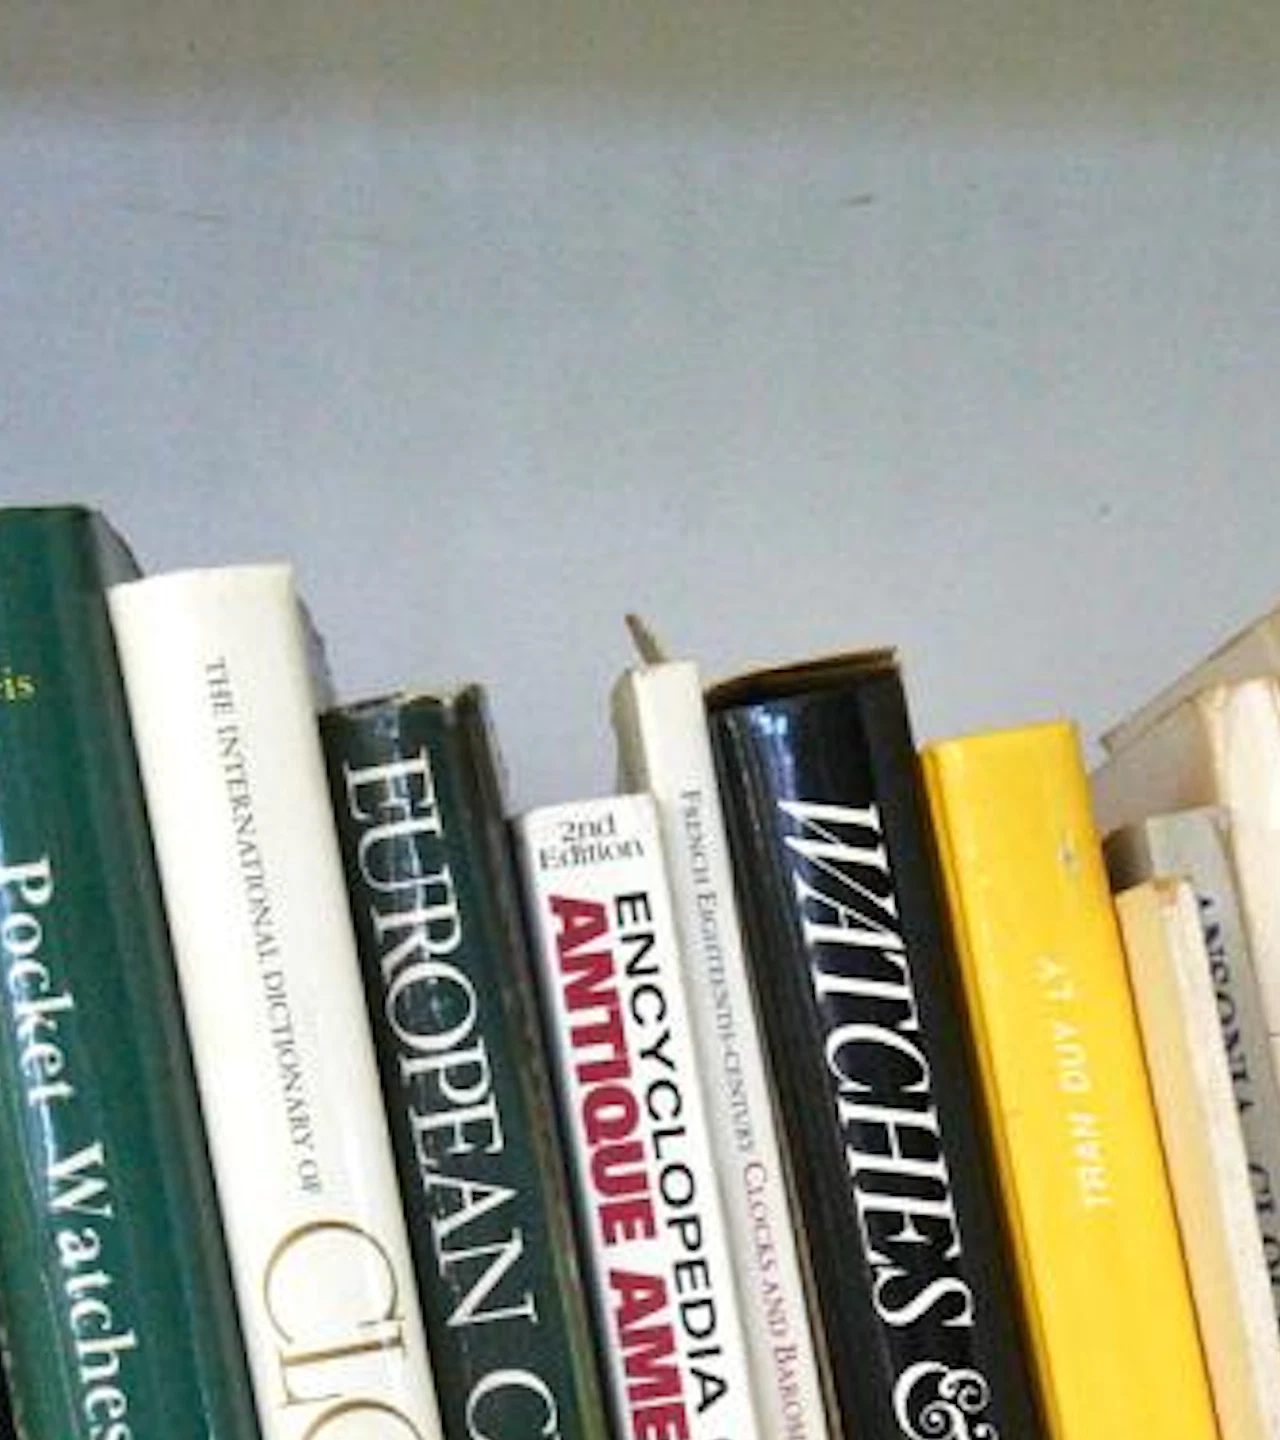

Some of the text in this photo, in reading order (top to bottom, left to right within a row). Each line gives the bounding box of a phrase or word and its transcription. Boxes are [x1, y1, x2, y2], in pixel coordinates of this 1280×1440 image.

[203, 658, 322, 1196] THE INTERNATIONAL DICTIONARY OF
[342, 748, 539, 1329] EUROPEAN
[539, 839, 645, 871] Edition
[547, 893, 658, 1247] ANTIQUE
[559, 811, 616, 842] 2nd
[776, 798, 977, 1327] WATCHES
[613, 890, 729, 1414] ENCYCLOPEDIA
